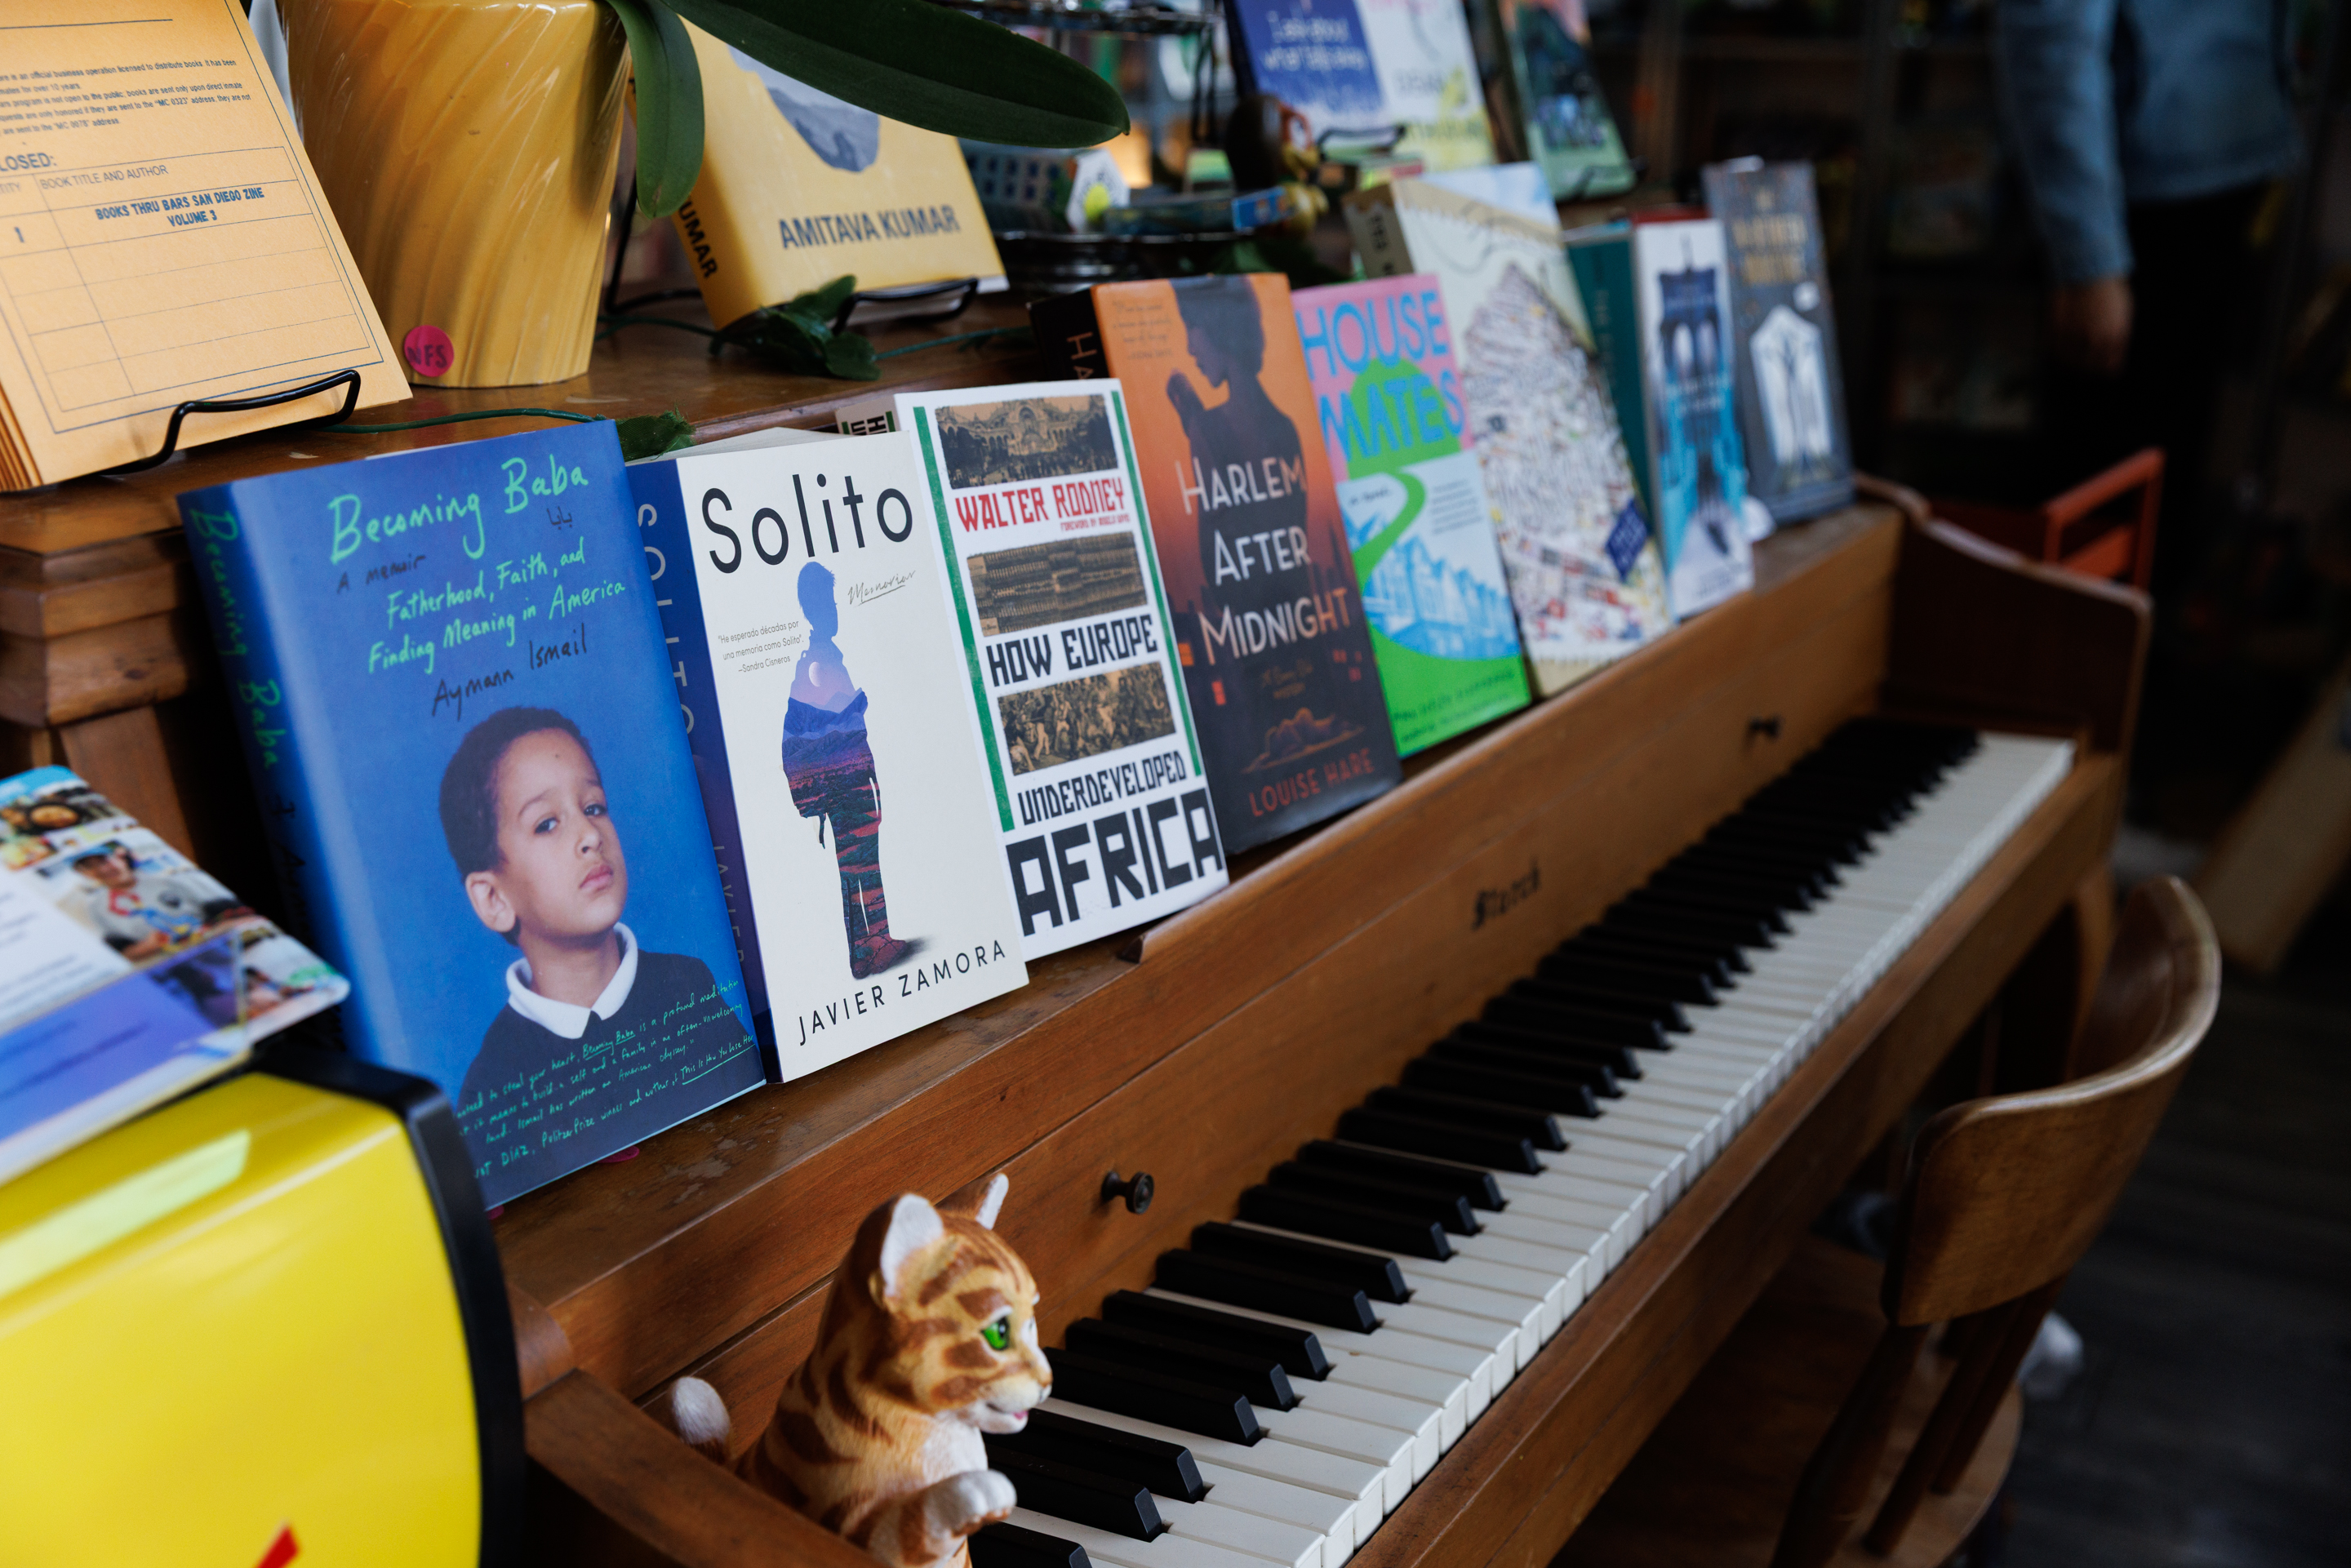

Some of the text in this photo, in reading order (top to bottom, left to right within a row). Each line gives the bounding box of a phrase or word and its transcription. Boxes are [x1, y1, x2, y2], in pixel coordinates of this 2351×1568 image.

[53, 69, 84, 78] business
[85, 67, 117, 76] operation
[154, 61, 184, 70] distribute
[118, 103, 134, 111] sent
[143, 100, 153, 109] the
[217, 95, 230, 103] they
[126, 88, 147, 97] books
[149, 87, 159, 96] are
[160, 86, 176, 94] sent
[175, 85, 189, 93] only
[189, 84, 206, 92] upon
[206, 82, 223, 91] direct
[223, 82, 243, 90] inmate
[40, 177, 73, 189] BOOK
[72, 173, 101, 185] TITLE
[103, 171, 124, 181] AND
[127, 165, 169, 178] AUTHOR
[95, 187, 264, 220] BOOKS THRU BARS SAN DIEGO ZINE
[14, 226, 24, 242] 1
[167, 210, 217, 227] VOLUME 3
[678, 197, 719, 279] UMAR
[778, 204, 961, 249] AMITAVA KUMAR
[407, 344, 448, 369] NFS
[1295, 290, 1449, 381] HOUSE
[1318, 368, 1465, 463] MATES
[327, 454, 589, 566] Becoming Baba
[955, 478, 1127, 532] WALTER RODNEY
[1174, 454, 1309, 515] HARLEM
[701, 473, 913, 574] Solito
[1214, 526, 1312, 586] AFTER
[336, 555, 427, 594] A memoir
[388, 535, 586, 630] Fatherhood, Faith, and
[189, 507, 248, 655] Becoming
[238, 679, 287, 769] Baba
[368, 579, 626, 674] Finding Meaning in America
[722, 651, 735, 660] una
[736, 644, 763, 658] memoria
[764, 642, 782, 651] como
[731, 628, 759, 642] esperado
[760, 623, 787, 635] décadas
[788, 620, 799, 631] por
[765, 655, 791, 667] Cisneros
[986, 614, 1158, 687] HOW EUROPE
[1198, 587, 1350, 666] MIDNIGHT
[431, 622, 588, 722] Aymann Ismail
[1017, 750, 1186, 826] UNDERDEVELOPED
[1249, 748, 1375, 817] LOUISE HARE
[1005, 787, 1224, 937] AFRICA
[798, 939, 1006, 1046] JAVIER ZAMORA
[490, 1089, 498, 1101] to
[503, 1072, 524, 1095] steal
[529, 1068, 546, 1090] your
[583, 1041, 614, 1060] Becoming
[616, 1030, 636, 1045] Baba
[639, 1019, 647, 1032] is
[664, 993, 695, 1025] profound
[700, 979, 739, 1003] meditation
[522, 1096, 529, 1108] to
[532, 1082, 553, 1100] build
[571, 1068, 586, 1084] self
[593, 1056, 606, 1073] and
[621, 1042, 646, 1060] family
[651, 1037, 656, 1047] in
[518, 1108, 544, 1129] Ismail
[549, 1103, 563, 1114] has
[569, 1086, 596, 1106] written
[602, 1080, 611, 1089] an
[619, 1064, 651, 1082] American
[541, 1130, 573, 1148] Pulitzer
[574, 1117, 595, 1134] Prize
[600, 1103, 622, 1120] winner
[629, 1089, 642, 1106] and
[645, 1080, 669, 1097] author
[672, 1073, 678, 1086] of
[680, 1064, 696, 1080] This
[705, 1054, 716, 1065] How
[718, 1046, 727, 1059] You
[729, 1042, 742, 1054] Lose
[743, 1034, 753, 1045] Her
